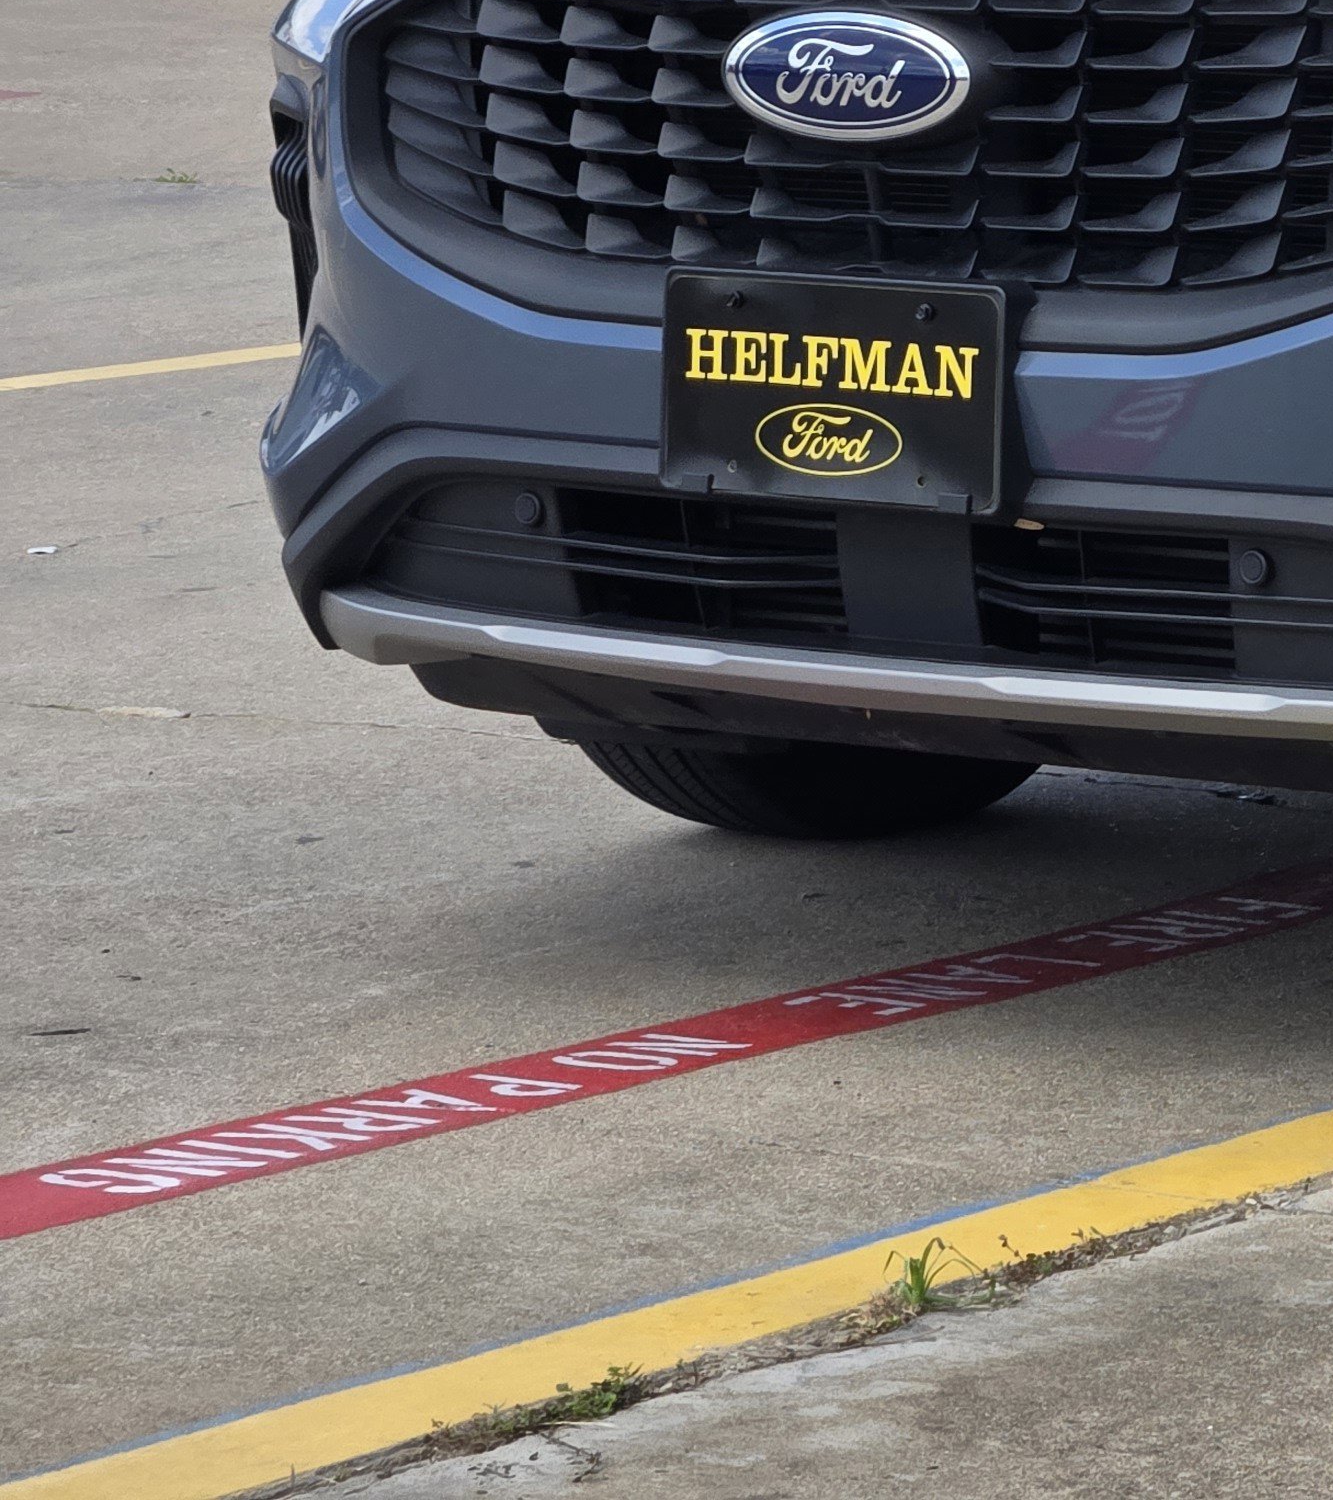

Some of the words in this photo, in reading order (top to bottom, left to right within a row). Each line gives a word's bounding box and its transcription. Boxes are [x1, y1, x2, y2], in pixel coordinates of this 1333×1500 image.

[775, 37, 905, 108] Ford
[685, 328, 979, 399] HELFMAN
[782, 410, 872, 464] Ford
[1058, 896, 1324, 953] FIRE
[783, 953, 1101, 1016] LANE
[552, 1033, 754, 1071] NO
